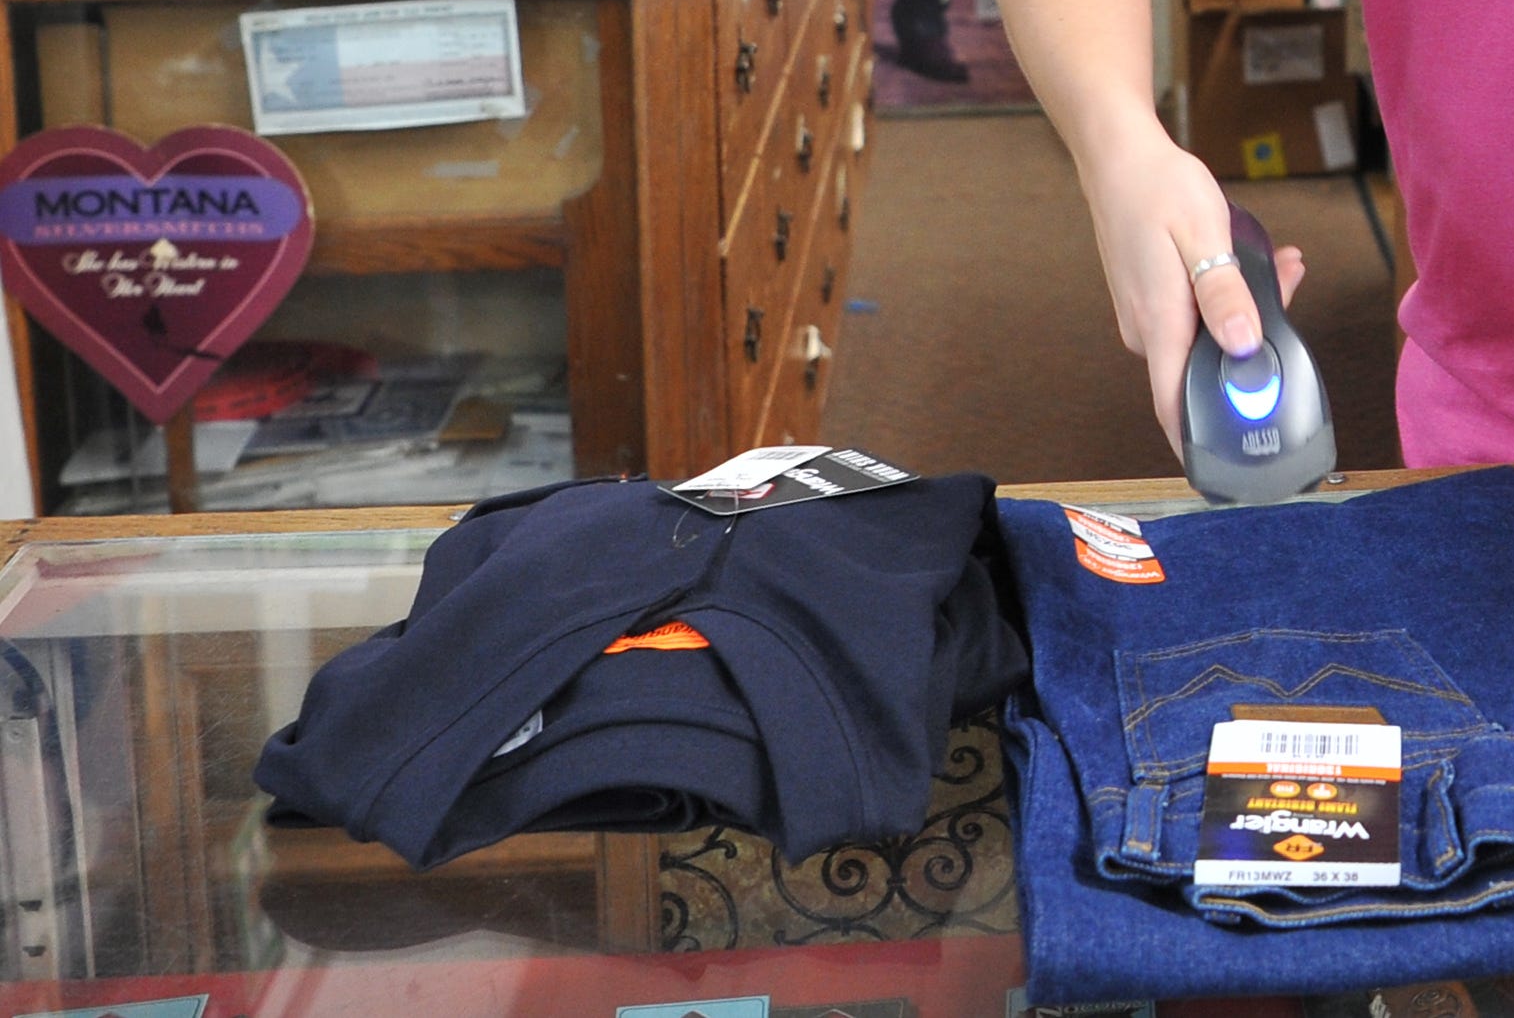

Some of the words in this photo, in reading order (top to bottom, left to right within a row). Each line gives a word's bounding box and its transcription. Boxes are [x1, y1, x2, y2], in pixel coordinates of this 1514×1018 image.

[35, 188, 260, 218] MONTANA
[34, 220, 265, 238] SILVERSMITHS
[1229, 809, 1370, 840] Wrangler
[1228, 869, 1293, 882] FR13MWZ
[1312, 870, 1328, 882] 36
[1332, 870, 1340, 882] X
